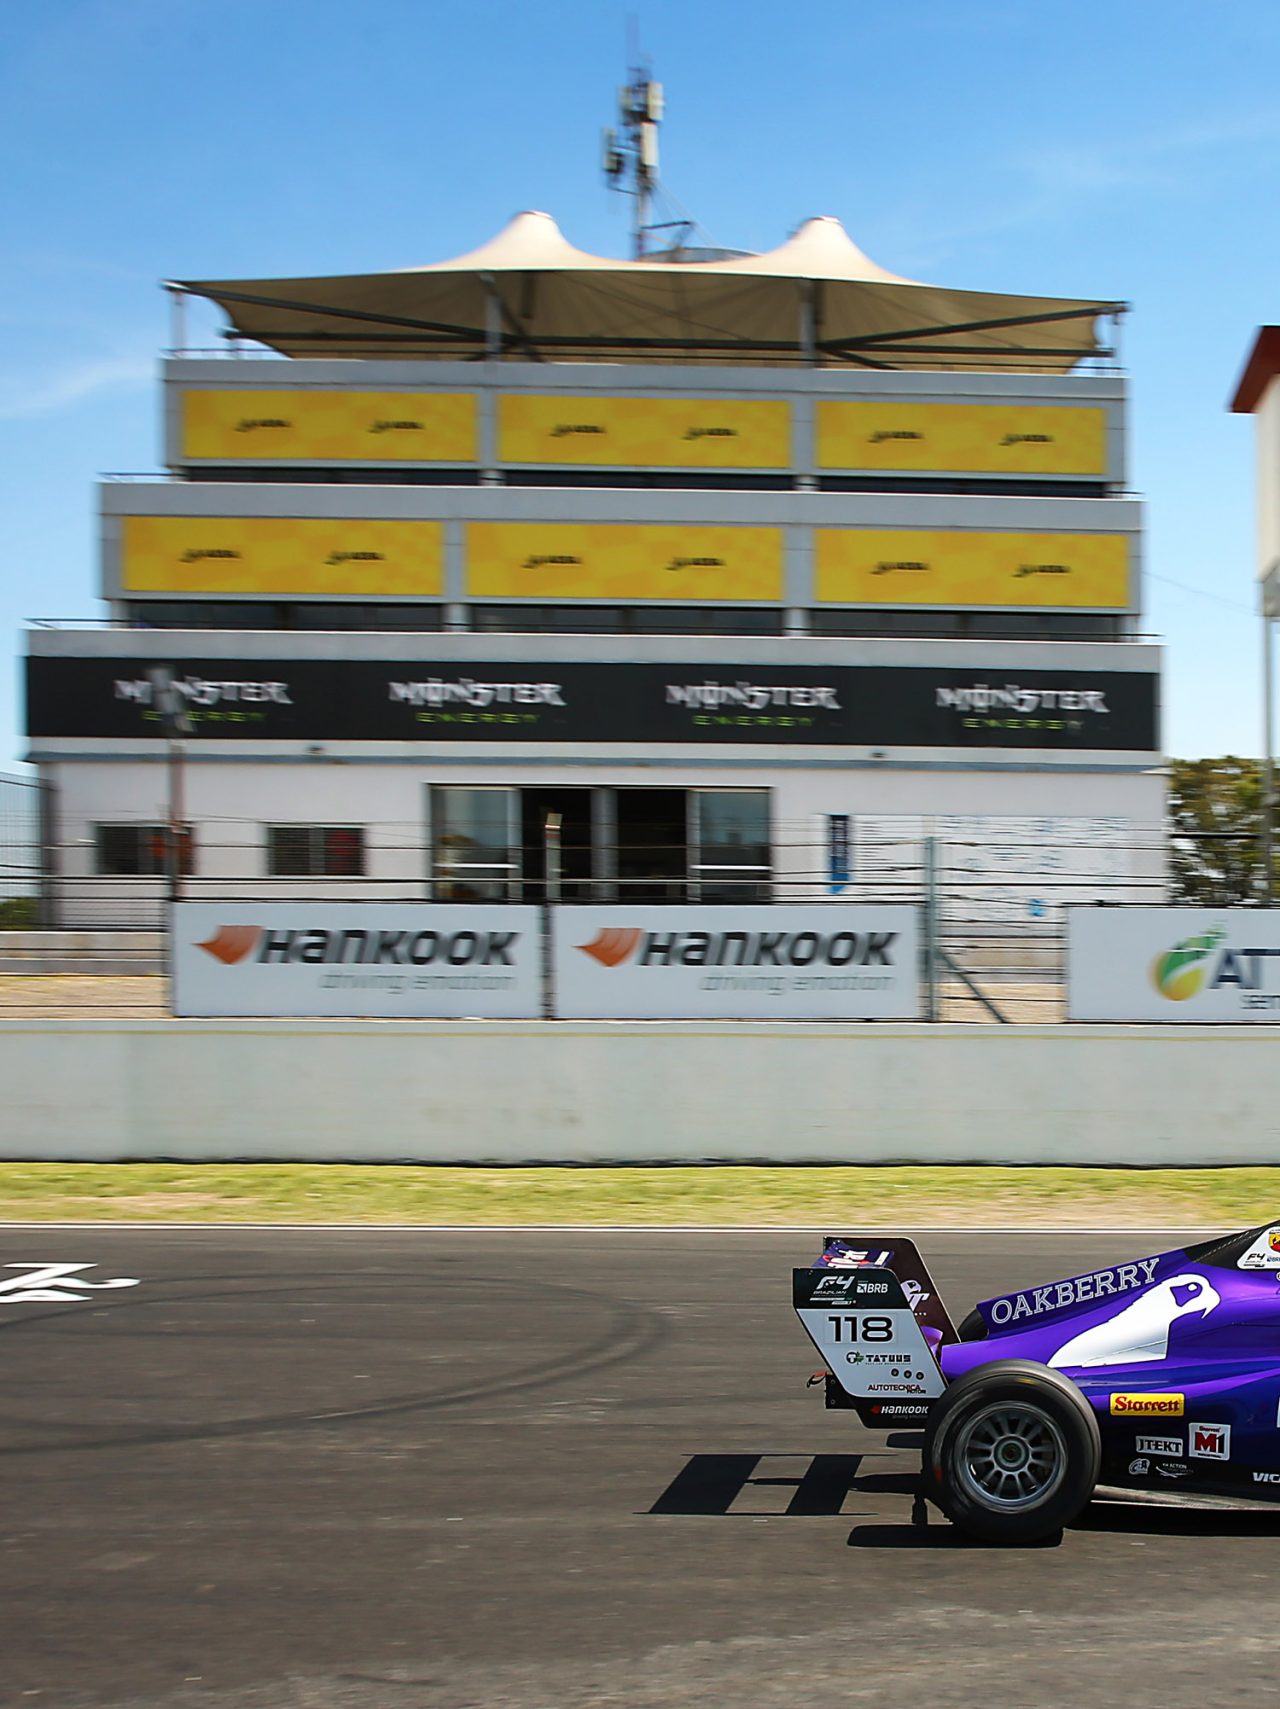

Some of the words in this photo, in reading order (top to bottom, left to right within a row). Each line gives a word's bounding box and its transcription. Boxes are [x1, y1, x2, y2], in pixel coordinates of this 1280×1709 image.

[114, 675, 294, 705] MNSTER
[388, 677, 568, 708] MONSTER
[665, 680, 843, 710] MONSTER
[935, 683, 1112, 713] MONSTER
[142, 710, 268, 722] EERGY
[867, 1283, 889, 1294] BRB
[991, 1257, 1160, 1324] OAKBERRY
[828, 1315, 894, 1343] 118
[1114, 1395, 1182, 1413] Starrett
[1138, 1438, 1182, 1453] JTEKT
[1194, 1431, 1226, 1455] M1
